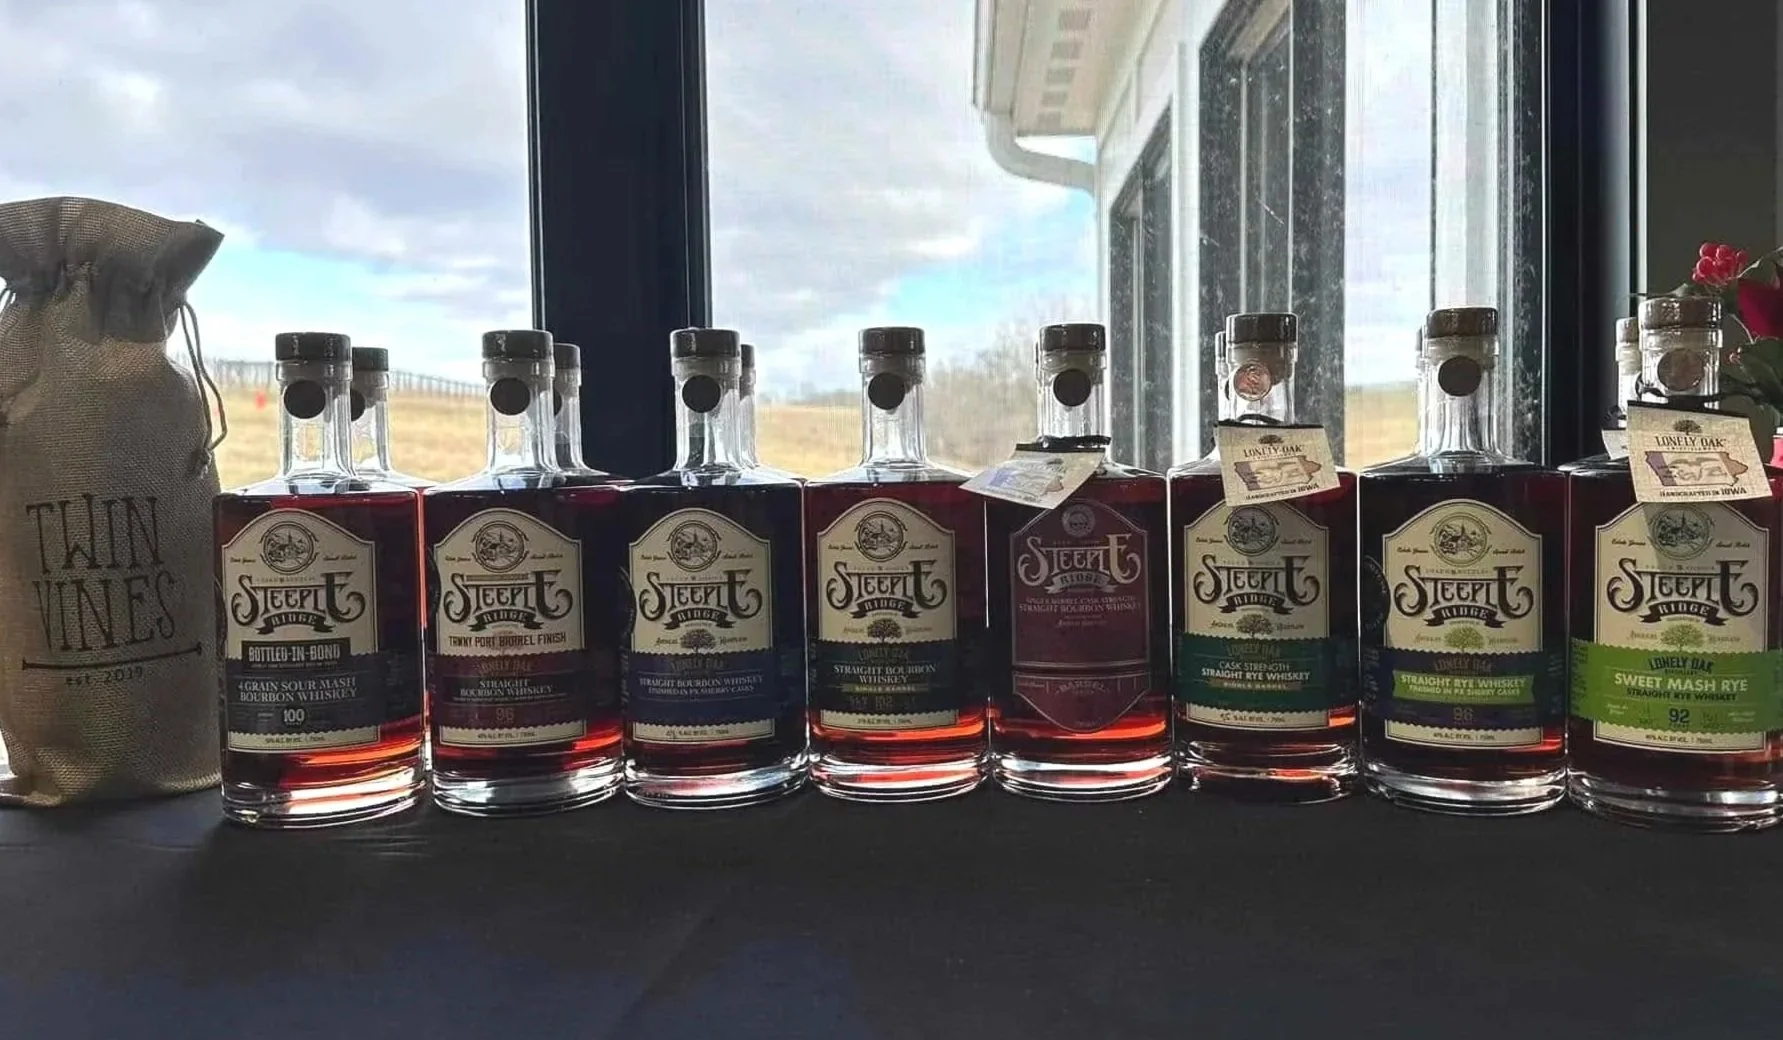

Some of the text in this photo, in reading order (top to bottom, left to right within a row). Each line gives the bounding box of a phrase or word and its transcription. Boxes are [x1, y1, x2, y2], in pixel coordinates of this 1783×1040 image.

[1655, 436, 1724, 447] LONELY OAK
[1243, 445, 1303, 458] LONELY OAK
[1298, 483, 1319, 493] IOWA
[1721, 487, 1747, 496] IOWA
[26, 493, 164, 573] TWIN
[1060, 574, 1100, 585] RIDGE
[863, 599, 906, 611] RIDGE
[1234, 594, 1276, 606] RIDGE
[32, 570, 175, 650] VINES
[1019, 603, 1058, 613] STRAIGHT
[1060, 603, 1104, 613] BOURBON
[1440, 607, 1488, 619] RIDGE
[1657, 602, 1710, 616] RIDGE
[270, 613, 318, 626] RIDGE
[482, 611, 527, 623] RIDGE
[677, 610, 720, 622] RIDGE
[449, 632, 566, 647] TAWNY PORT BARREL FINISH
[248, 643, 341, 662] BOTTLED-IN-BOND
[834, 663, 937, 674] STRAIGHT BOURBON
[1219, 661, 1290, 672] CASK STRENGTH
[1650, 656, 1714, 673] LONELY OAK
[104, 667, 143, 682] 2019
[859, 674, 908, 684] WHISKEY
[1202, 667, 1311, 681] STRAIGHT RYE WHISKEY
[281, 680, 316, 691] SOUR
[319, 676, 356, 689] MASH
[479, 678, 531, 688] STRAIGHT
[639, 675, 764, 688] STRAIGHT BOURBON WHISKEY
[1401, 674, 1526, 688] STRAIGHT RYE WHISKEY
[1614, 672, 1749, 692] SWEET MASH RYE
[240, 687, 357, 702] BOURBON WHISKEY
[460, 684, 553, 697] BOURBON WHISKEY
[1627, 687, 1737, 702] STRAIGHT RYE WHISKEY
[283, 708, 305, 722] 100
[1668, 708, 1690, 723] 92
